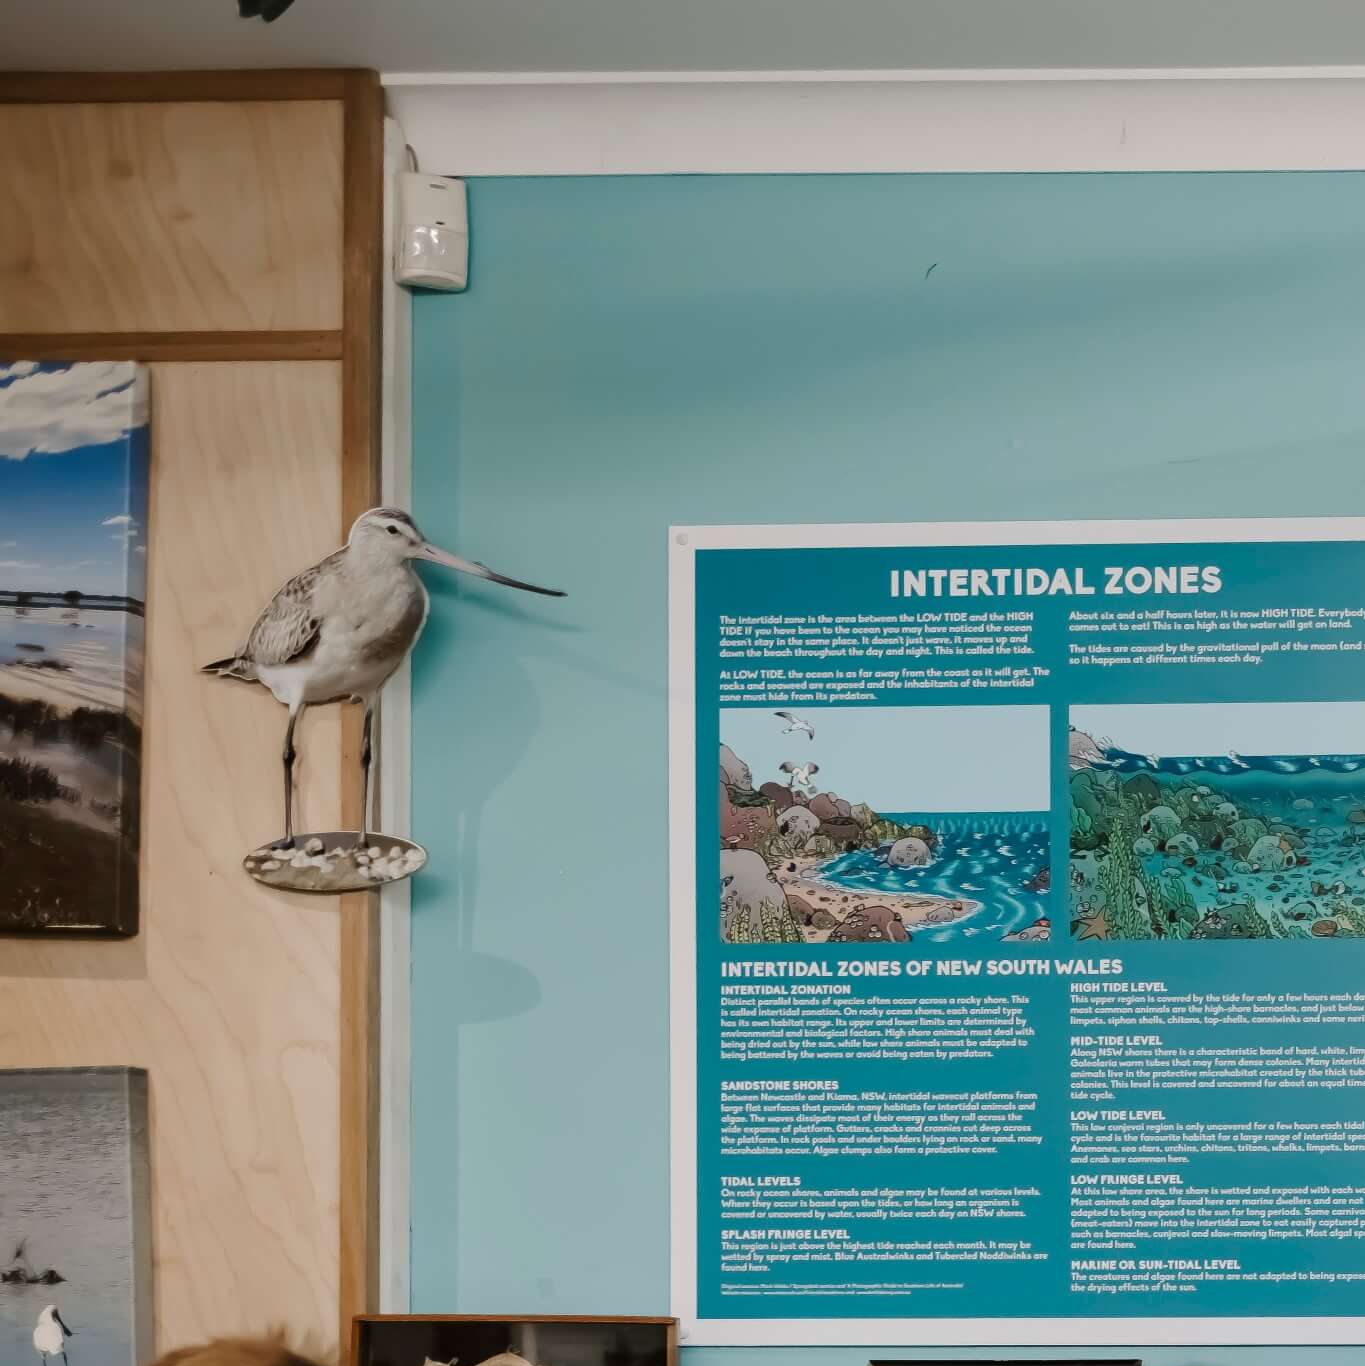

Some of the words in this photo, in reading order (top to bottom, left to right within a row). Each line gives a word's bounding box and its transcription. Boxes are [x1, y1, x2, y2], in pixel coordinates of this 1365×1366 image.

[890, 567, 1096, 598] INTERTIDAL
[1104, 565, 1223, 595] ZONES
[721, 961, 833, 978] INTERTIDAL
[837, 960, 902, 977] ZONES
[905, 960, 933, 977] OF
[936, 959, 983, 976] NEW
[986, 959, 1051, 976] SOUTH
[1053, 958, 1124, 975] WALES
[720, 984, 789, 996] INTERTIDAL
[790, 984, 852, 995] ZONATION
[1070, 982, 1101, 993] HIGH
[1101, 982, 1129, 993] TIDE
[1130, 981, 1169, 993] LEVEL
[1070, 1035, 1125, 1046] MID-TIDE
[1125, 1035, 1163, 1046] LEVEL
[720, 1080, 791, 1091] SANDSTONE
[792, 1080, 839, 1091] SHORES
[1070, 1110, 1099, 1121] LOW
[1099, 1110, 1127, 1121] TIDE
[1128, 1110, 1166, 1121] LEVEL
[720, 1176, 756, 1187] TIDAL
[757, 1176, 801, 1187] LEVELS
[1070, 1174, 1099, 1185] LOW
[1100, 1174, 1145, 1185] FRINGE
[1146, 1174, 1184, 1185] LEVEL
[721, 1229, 766, 1240] SPLASH
[767, 1229, 812, 1240] FRINGE
[813, 1229, 851, 1240] LEVEL
[1071, 1260, 1117, 1271] MARINE
[1118, 1260, 1137, 1270] OR
[1138, 1259, 1203, 1270] SUN-TIDAL
[1203, 1259, 1241, 1270] LEVEL
